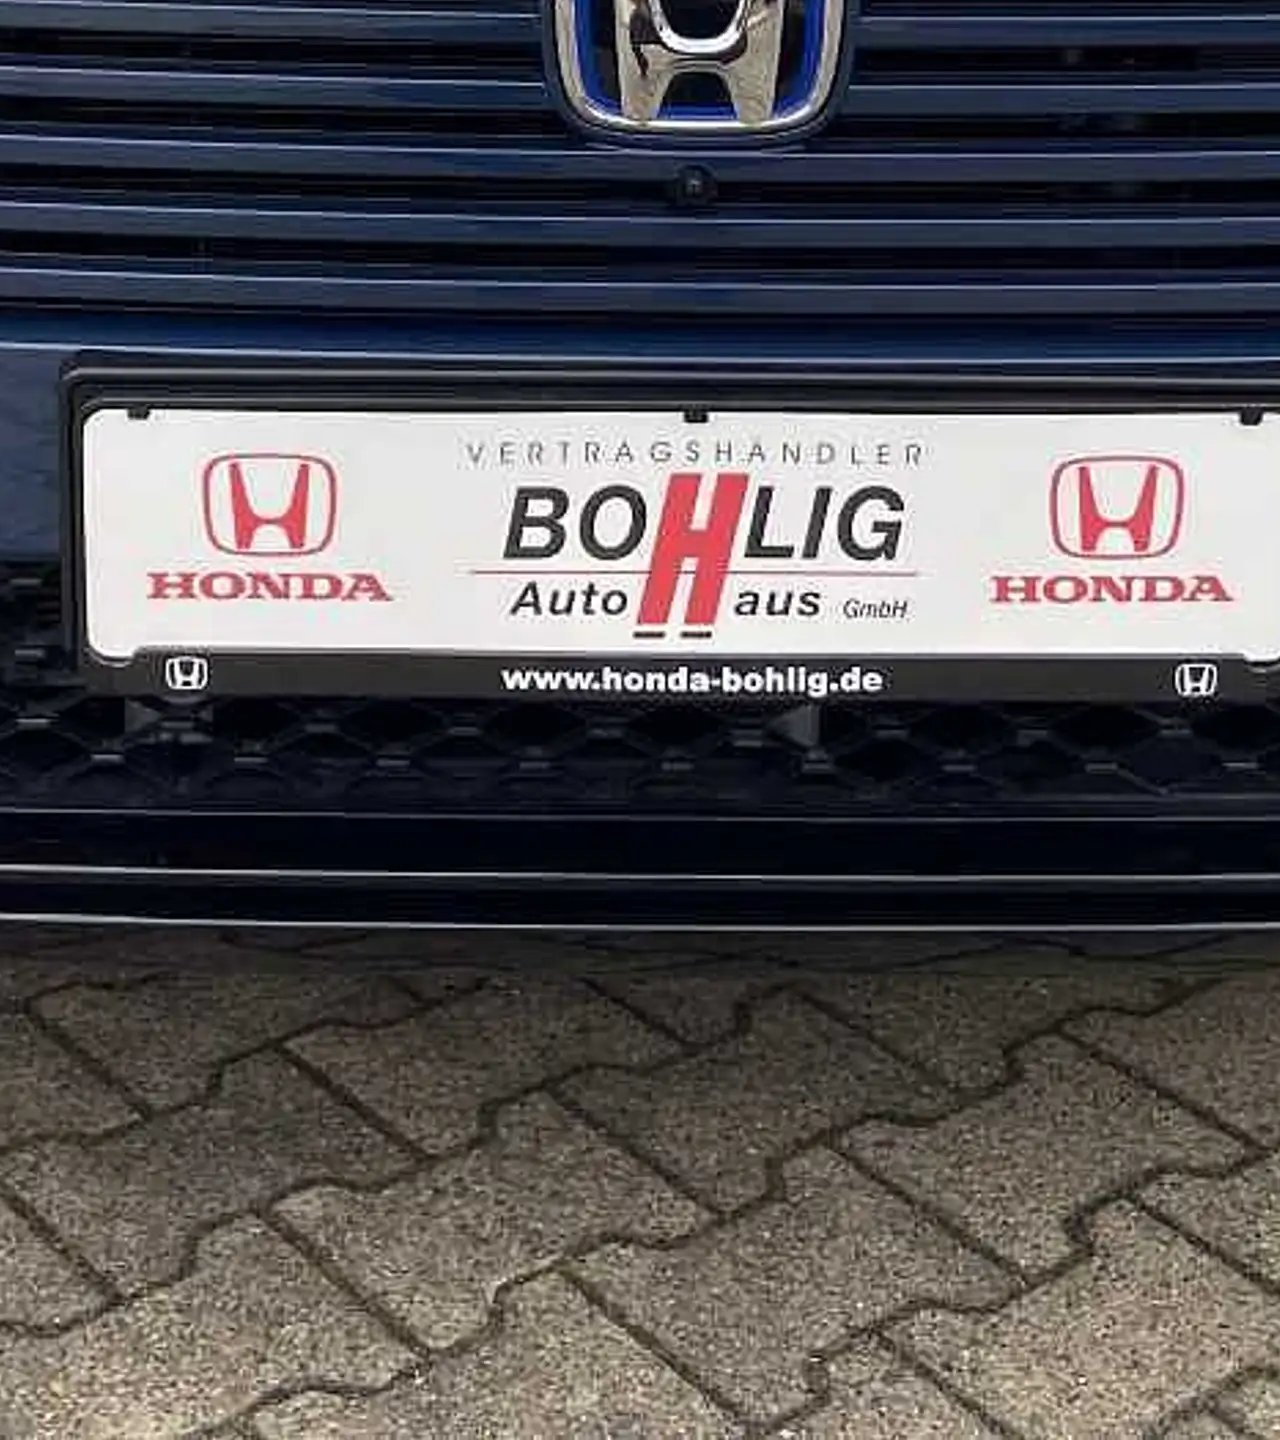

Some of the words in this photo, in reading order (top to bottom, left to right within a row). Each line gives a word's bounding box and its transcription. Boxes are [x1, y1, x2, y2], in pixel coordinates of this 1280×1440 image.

[503, 472, 907, 625] BOHLIG
[147, 571, 394, 601] HONDA
[989, 575, 1234, 602] HONDA
[843, 598, 909, 620] GmbH
[501, 666, 883, 697] www.honda-bohlig.de
